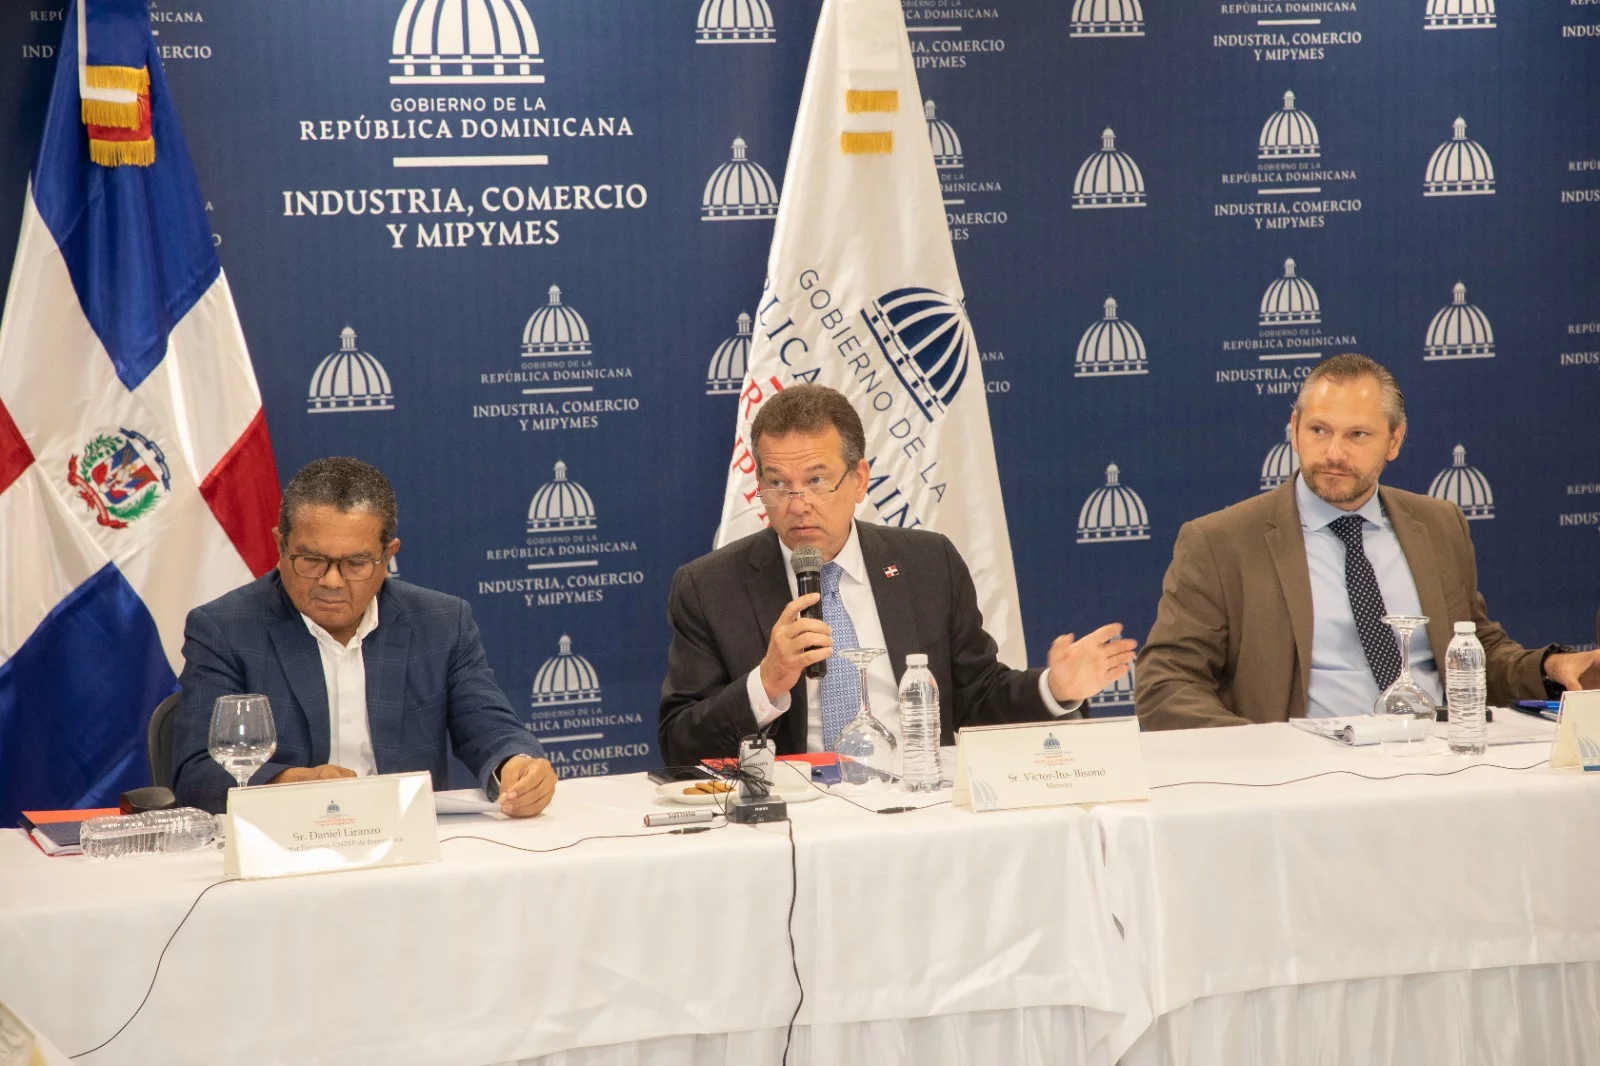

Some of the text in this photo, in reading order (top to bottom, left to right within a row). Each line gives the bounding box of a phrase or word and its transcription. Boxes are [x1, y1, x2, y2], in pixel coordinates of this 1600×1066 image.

[924, 9, 998, 19] DOMINICANA
[1222, 3, 1356, 13] REPÚBLICA DOMINICANA
[932, 40, 1004, 52] COMERCIO
[1214, 32, 1361, 46] INDUSTRIA, COMERCIO
[915, 55, 967, 69] IPYMES
[1254, 48, 1324, 61] Y MIPYMES
[391, 97, 546, 112] GOBIERNO DE LA
[300, 115, 633, 140] REPÚBLICA DOMINICANA
[1222, 171, 1357, 184] REPÚBLICA DOMINICANA
[283, 184, 647, 216] INDUSTRIA, COMERCIO
[1215, 199, 1362, 216] INDUSTRIA, COMERCIO
[946, 211, 1008, 225] OMERCIO
[1254, 216, 1324, 230] Y MIPYMES
[387, 220, 559, 248] Y MIPYMES
[1223, 336, 1357, 350] REPÚBLICA DOMINICANA
[481, 368, 633, 384] REPÚBLICA DOMINICANA
[1216, 368, 1292, 382] INDUSTRIA,
[799, 269, 894, 412] GOBIERNO
[889, 418, 926, 459] DE
[920, 462, 948, 503] LA
[1255, 383, 1265, 395] Y
[473, 398, 640, 418] INDUSTRIA, COMERCIO
[519, 416, 599, 431] Y MIPYMES
[486, 541, 638, 560] REPÚBLICA DOMINICANA
[479, 571, 644, 594] INDUSTRIA, COMERCIO
[524, 589, 604, 606] Y MIPYMES
[563, 713, 642, 728] DOMINICANA
[572, 743, 649, 761] COMERCIO
[293, 826, 381, 841] Sr. Daniel Liranzo
